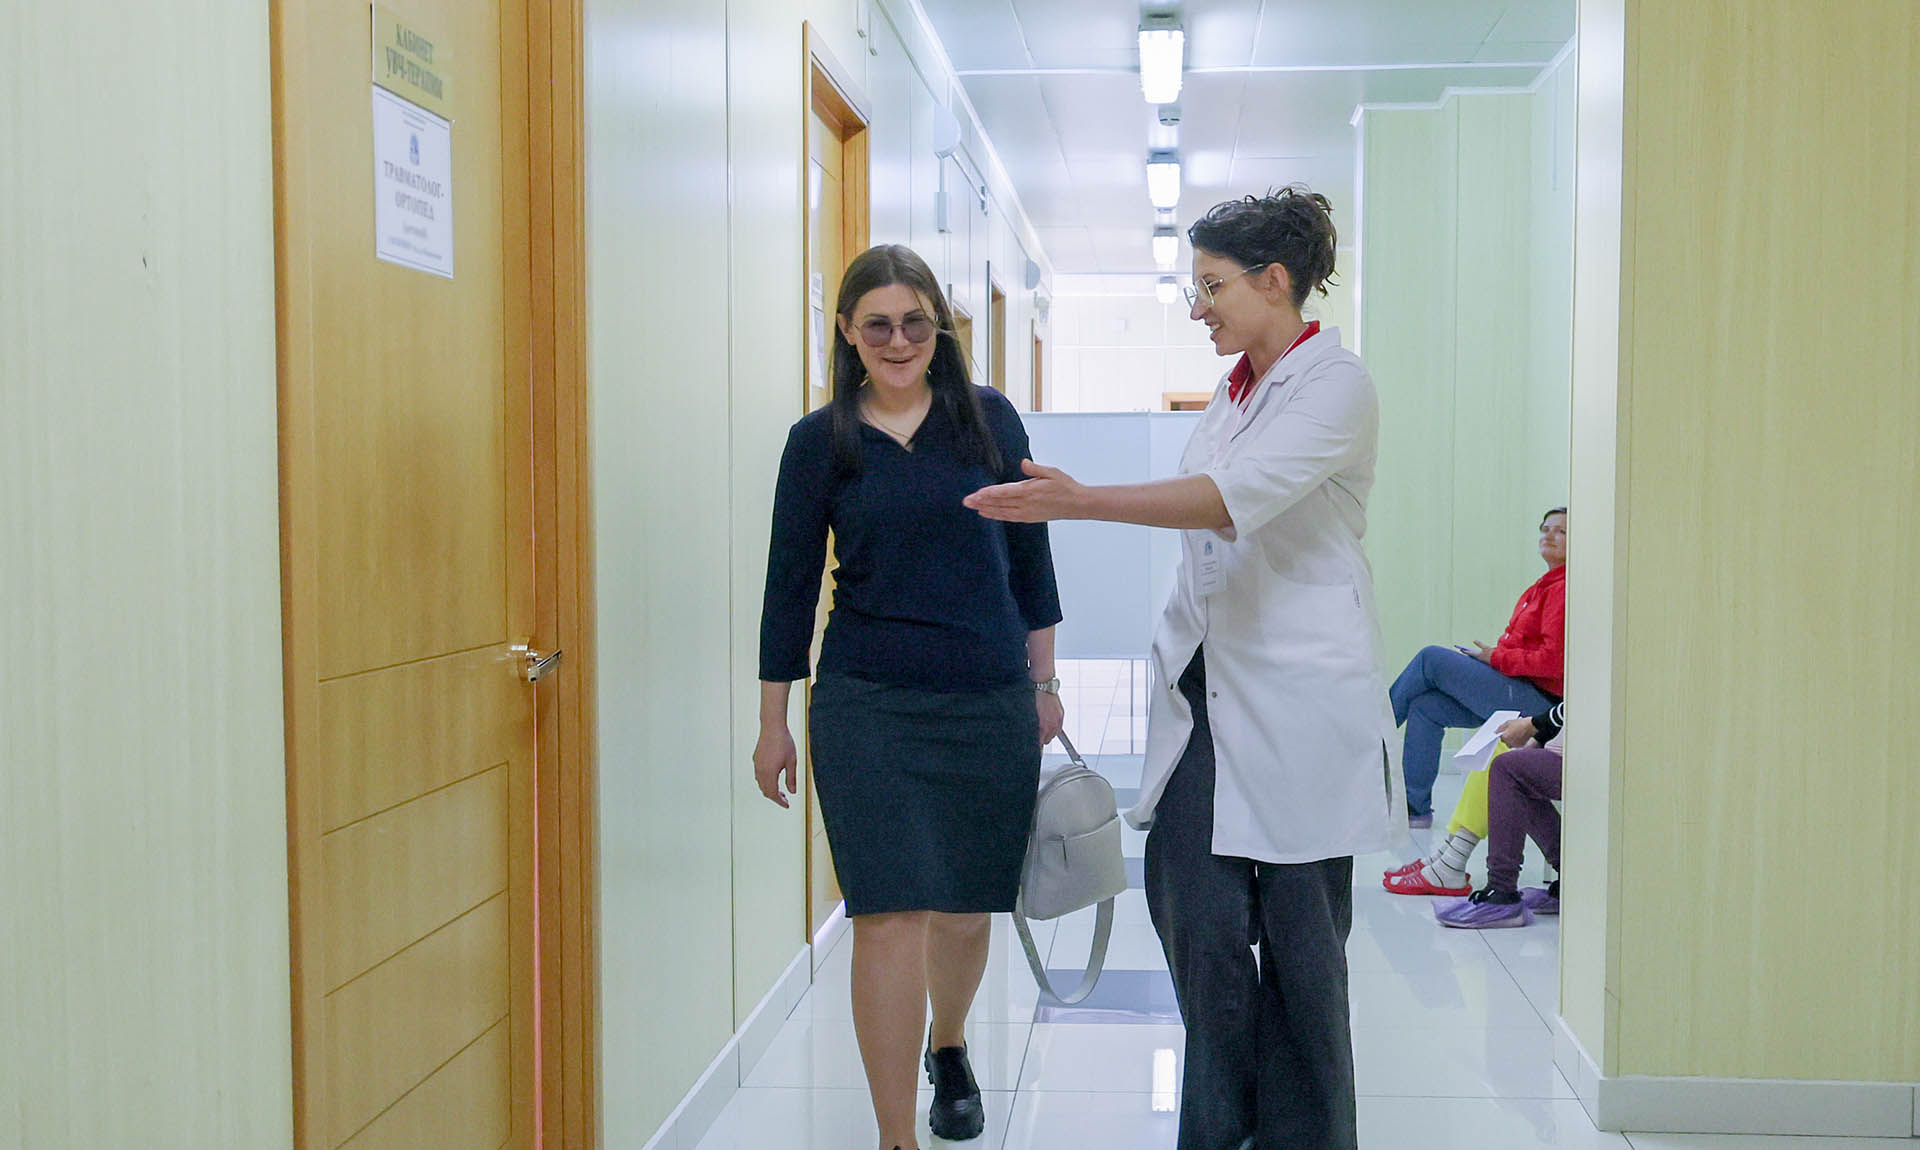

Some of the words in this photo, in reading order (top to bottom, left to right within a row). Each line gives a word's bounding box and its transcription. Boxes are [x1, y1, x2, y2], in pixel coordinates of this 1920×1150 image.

[396, 23, 433, 65] КАБИНЕТ
[383, 160, 444, 199] ТРАВМАТОЛОГ-
[395, 191, 434, 221] ОРТОПЕД
